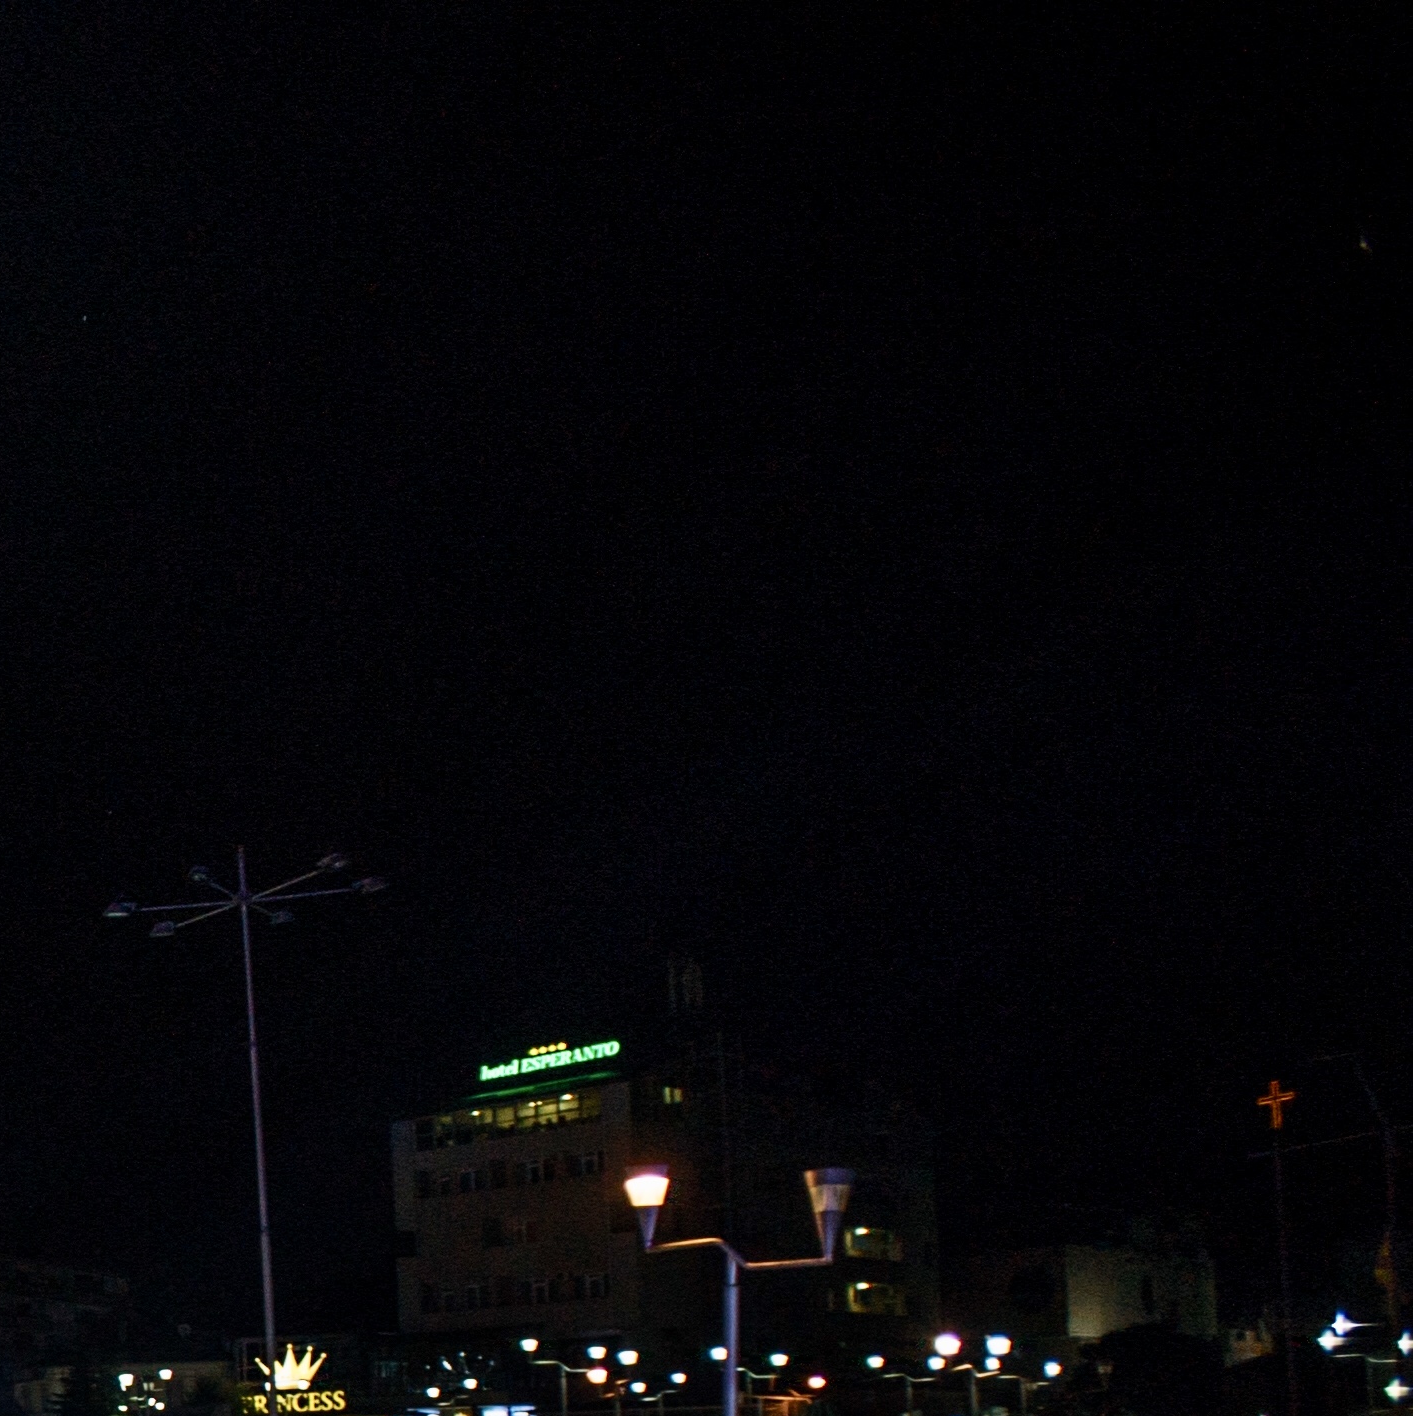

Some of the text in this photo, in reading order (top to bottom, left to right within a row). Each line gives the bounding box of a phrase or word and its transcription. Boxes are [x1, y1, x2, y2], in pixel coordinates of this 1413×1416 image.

[480, 1041, 620, 1081] hotel ESPERANTO
[241, 1390, 346, 1414] RNCESS
